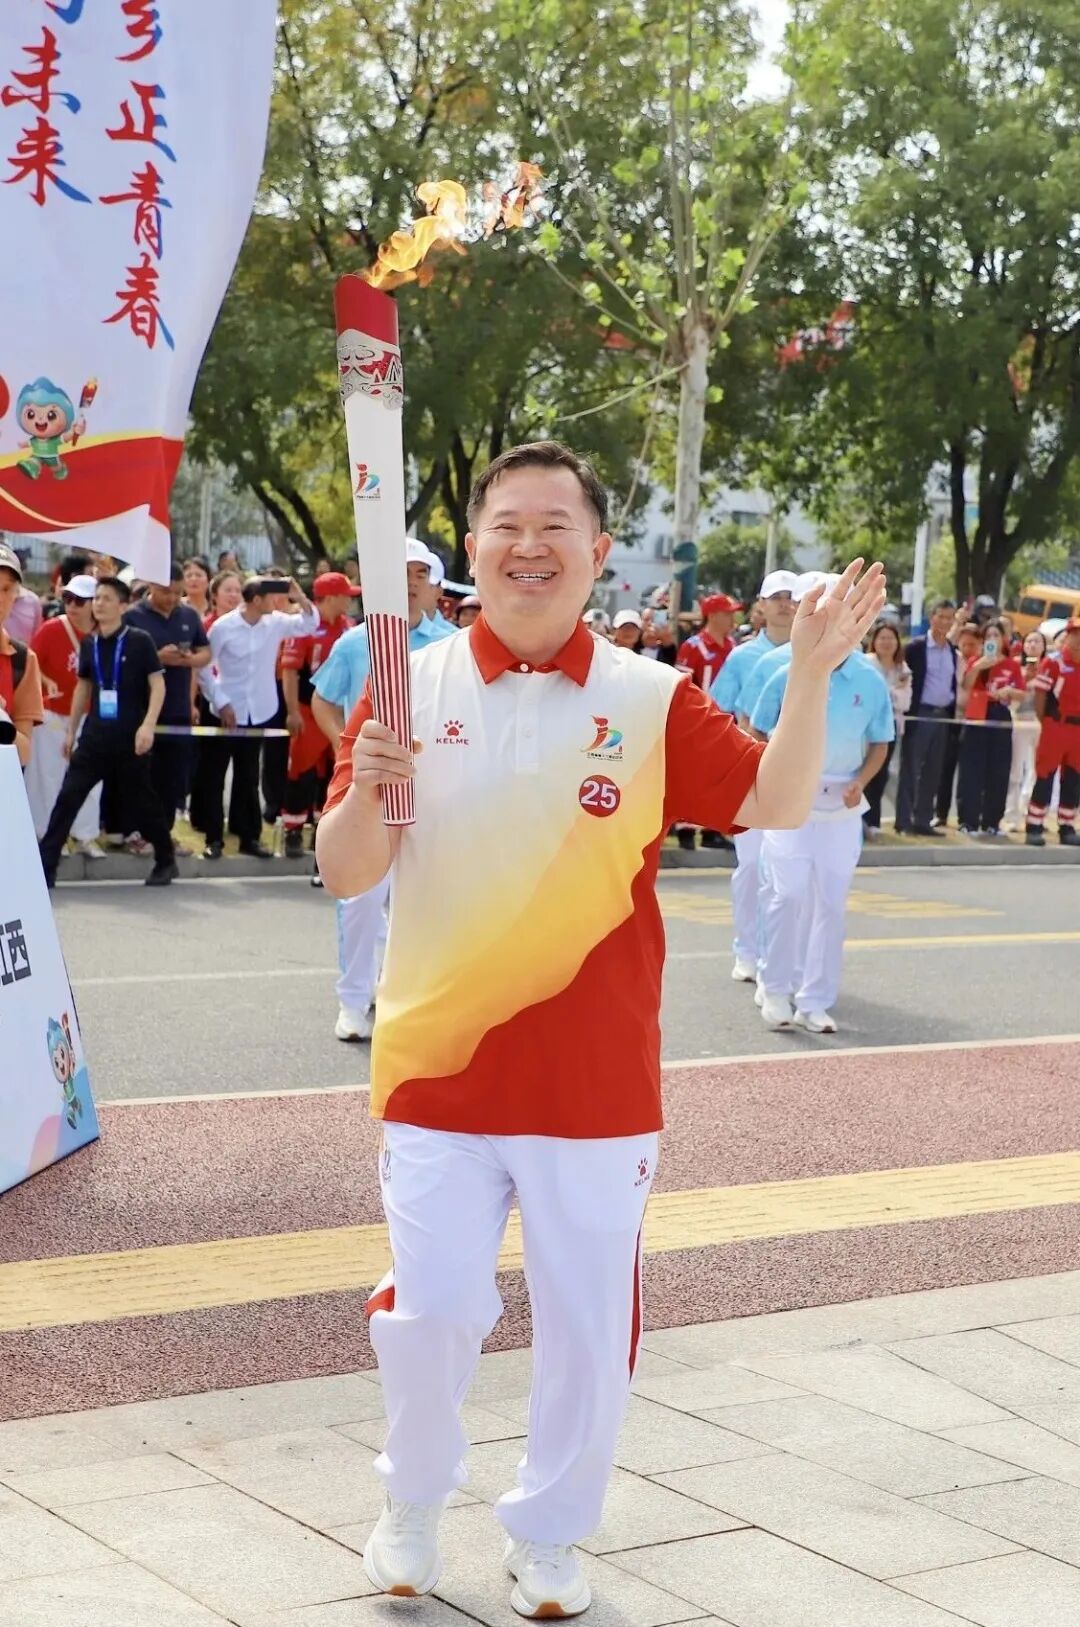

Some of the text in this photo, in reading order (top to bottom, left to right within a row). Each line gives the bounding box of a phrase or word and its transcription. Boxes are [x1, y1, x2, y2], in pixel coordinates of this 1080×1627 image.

[0, 0, 92, 206] 未来
[435, 737, 470, 745] KELME
[581, 780, 617, 809] 25
